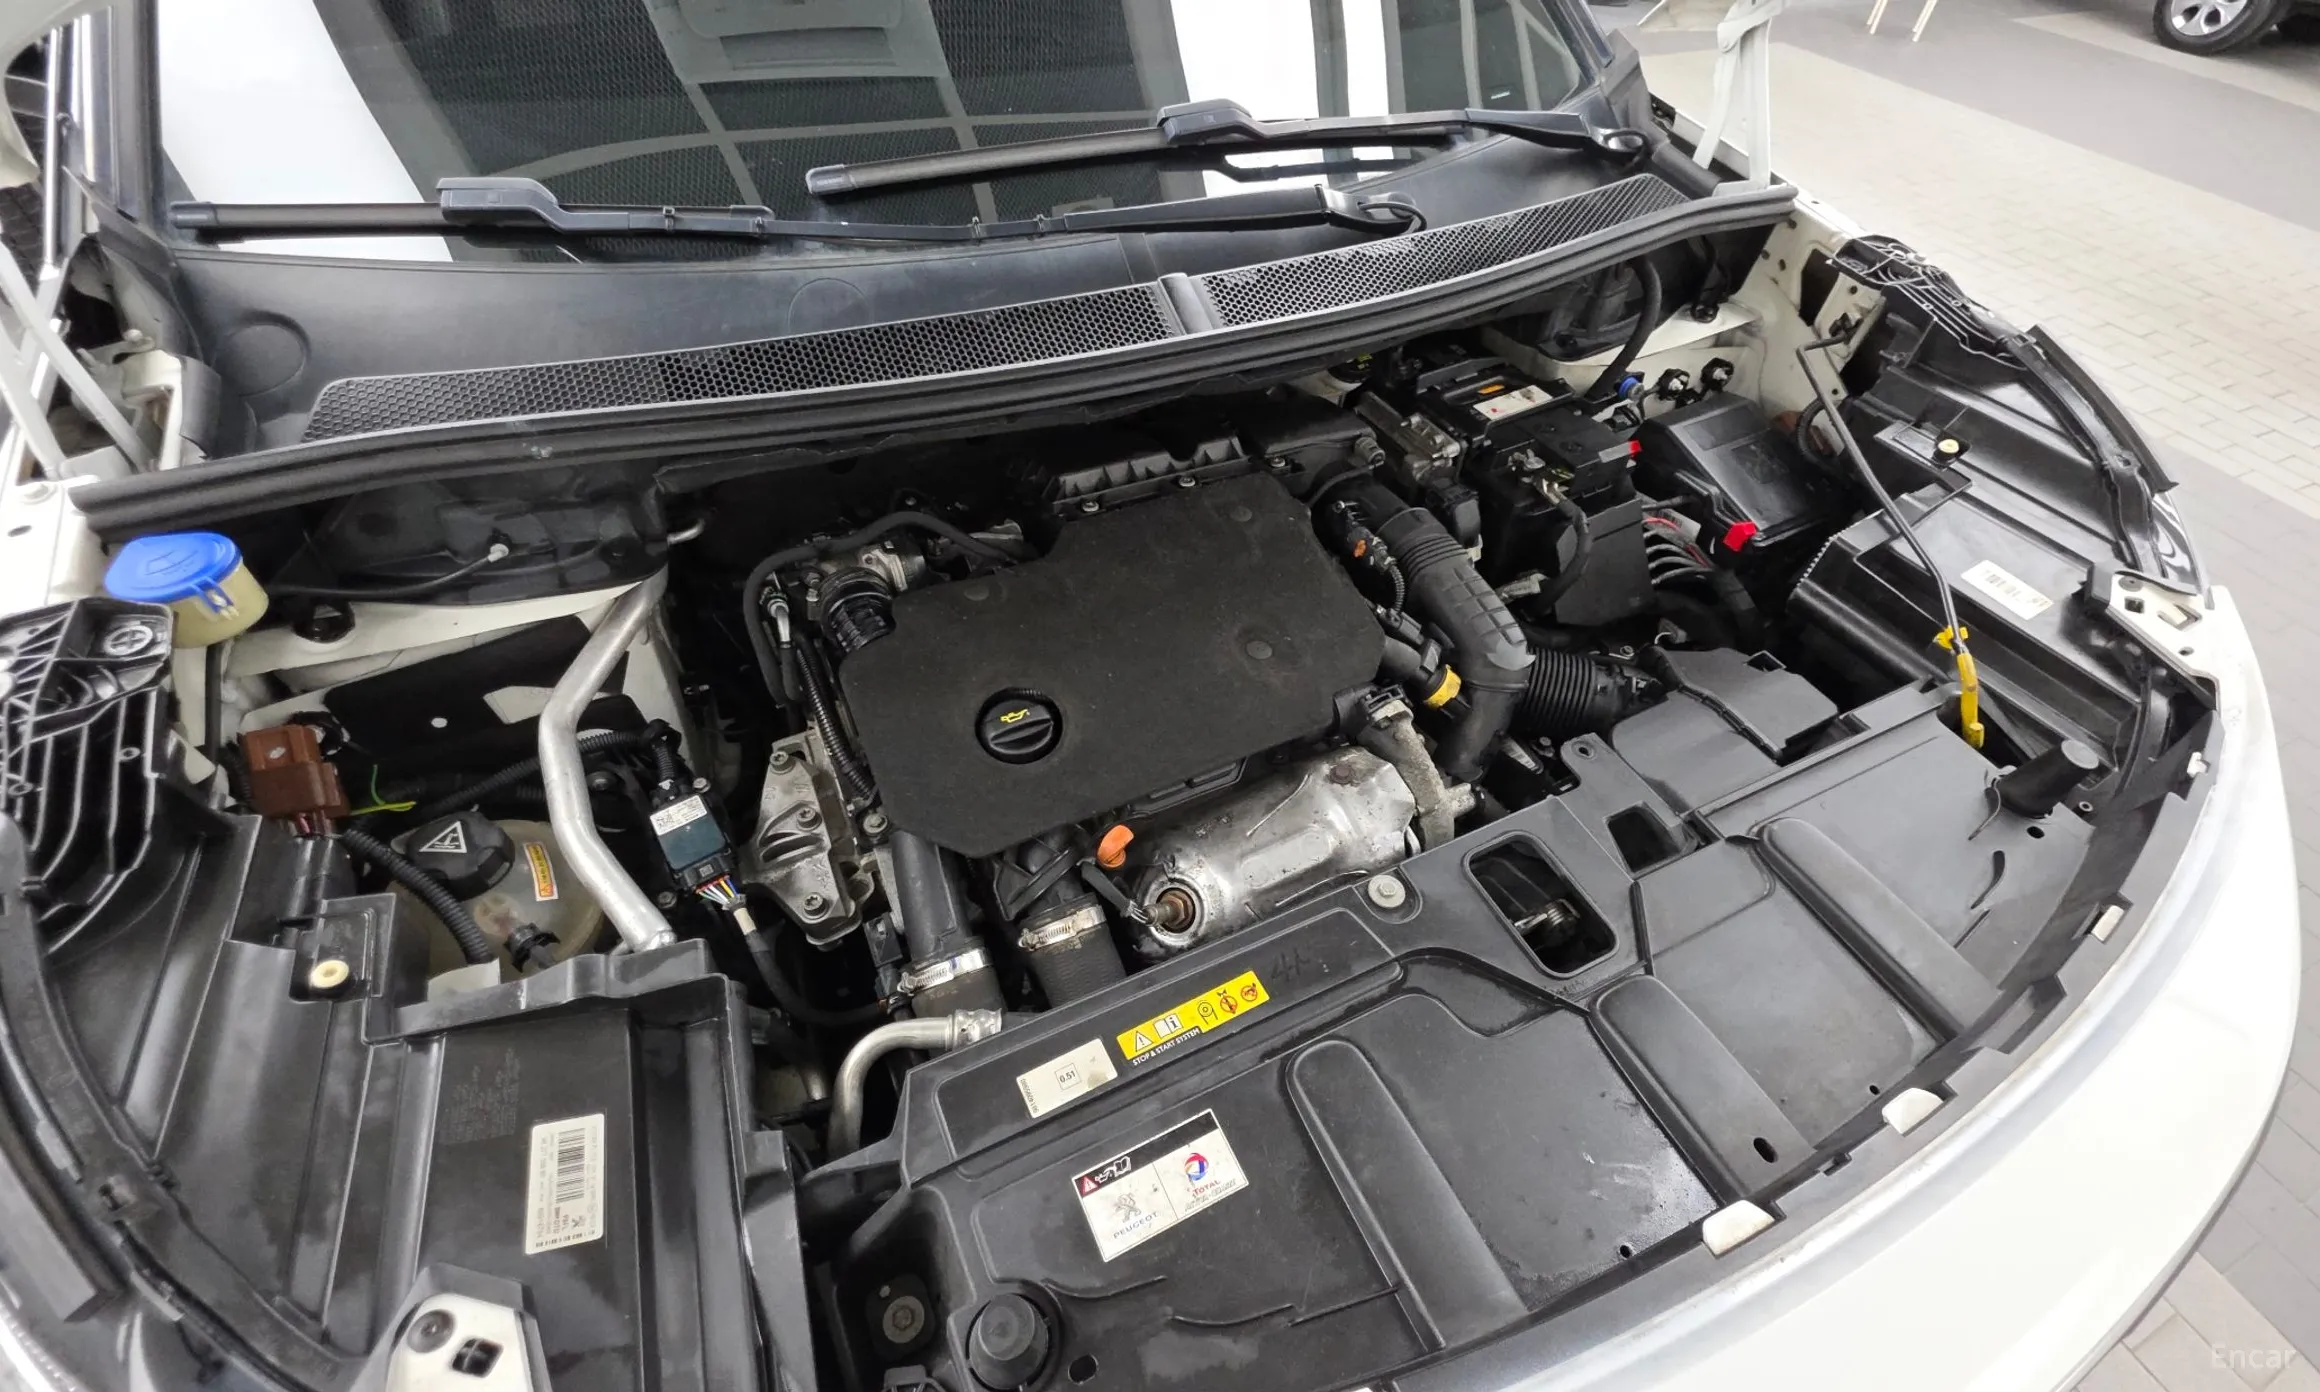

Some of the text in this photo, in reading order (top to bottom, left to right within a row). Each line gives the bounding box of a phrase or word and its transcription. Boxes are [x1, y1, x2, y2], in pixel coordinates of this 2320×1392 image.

[1132, 1052, 1151, 1066] STOP
[1156, 1039, 1178, 1055] START
[1176, 1028, 1201, 1046] SYSTEM
[1059, 1070, 1076, 1084] 0.51
[1192, 1179, 1222, 1196] TOTAL
[1112, 1211, 1159, 1240] PEUGEOT
